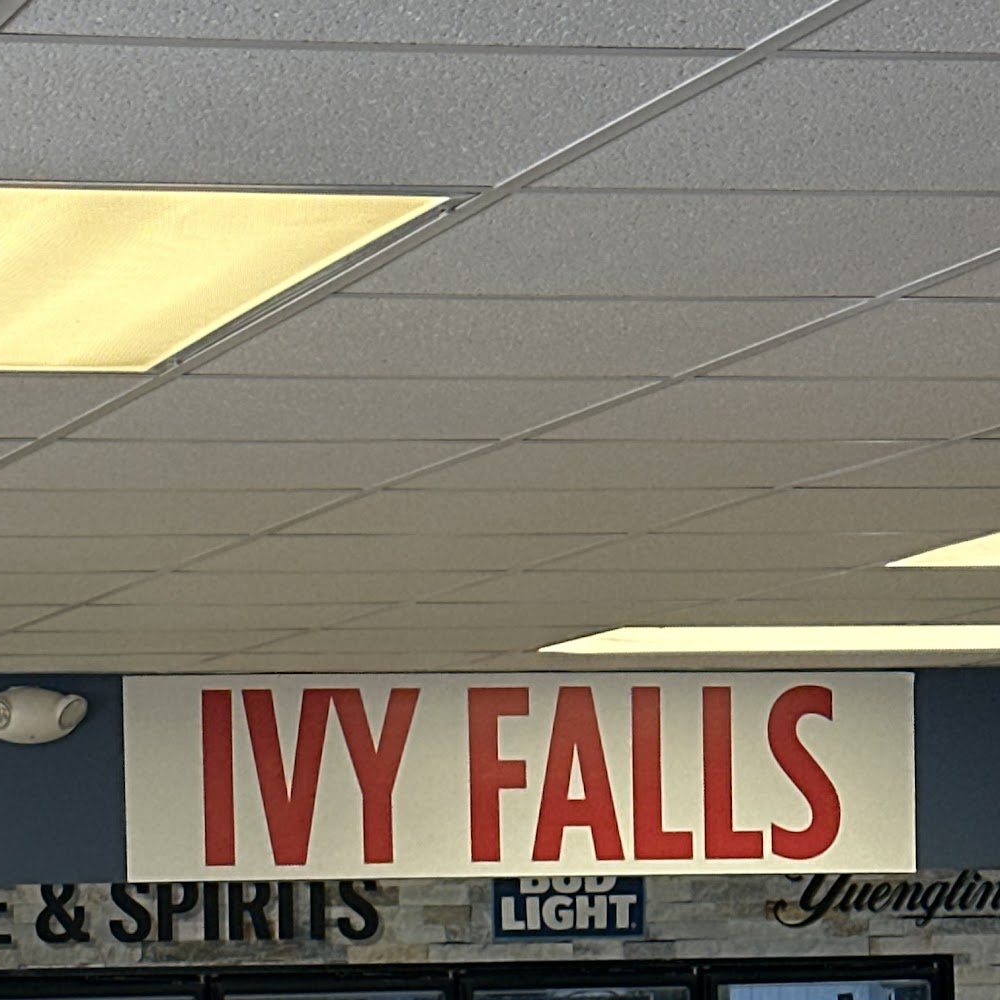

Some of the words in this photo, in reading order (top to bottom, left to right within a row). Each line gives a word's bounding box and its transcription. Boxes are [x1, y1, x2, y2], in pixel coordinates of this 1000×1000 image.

[203, 689, 418, 866] IVY
[470, 686, 842, 862] FALLS
[35, 884, 90, 943] &
[501, 895, 638, 931] LIGHT
